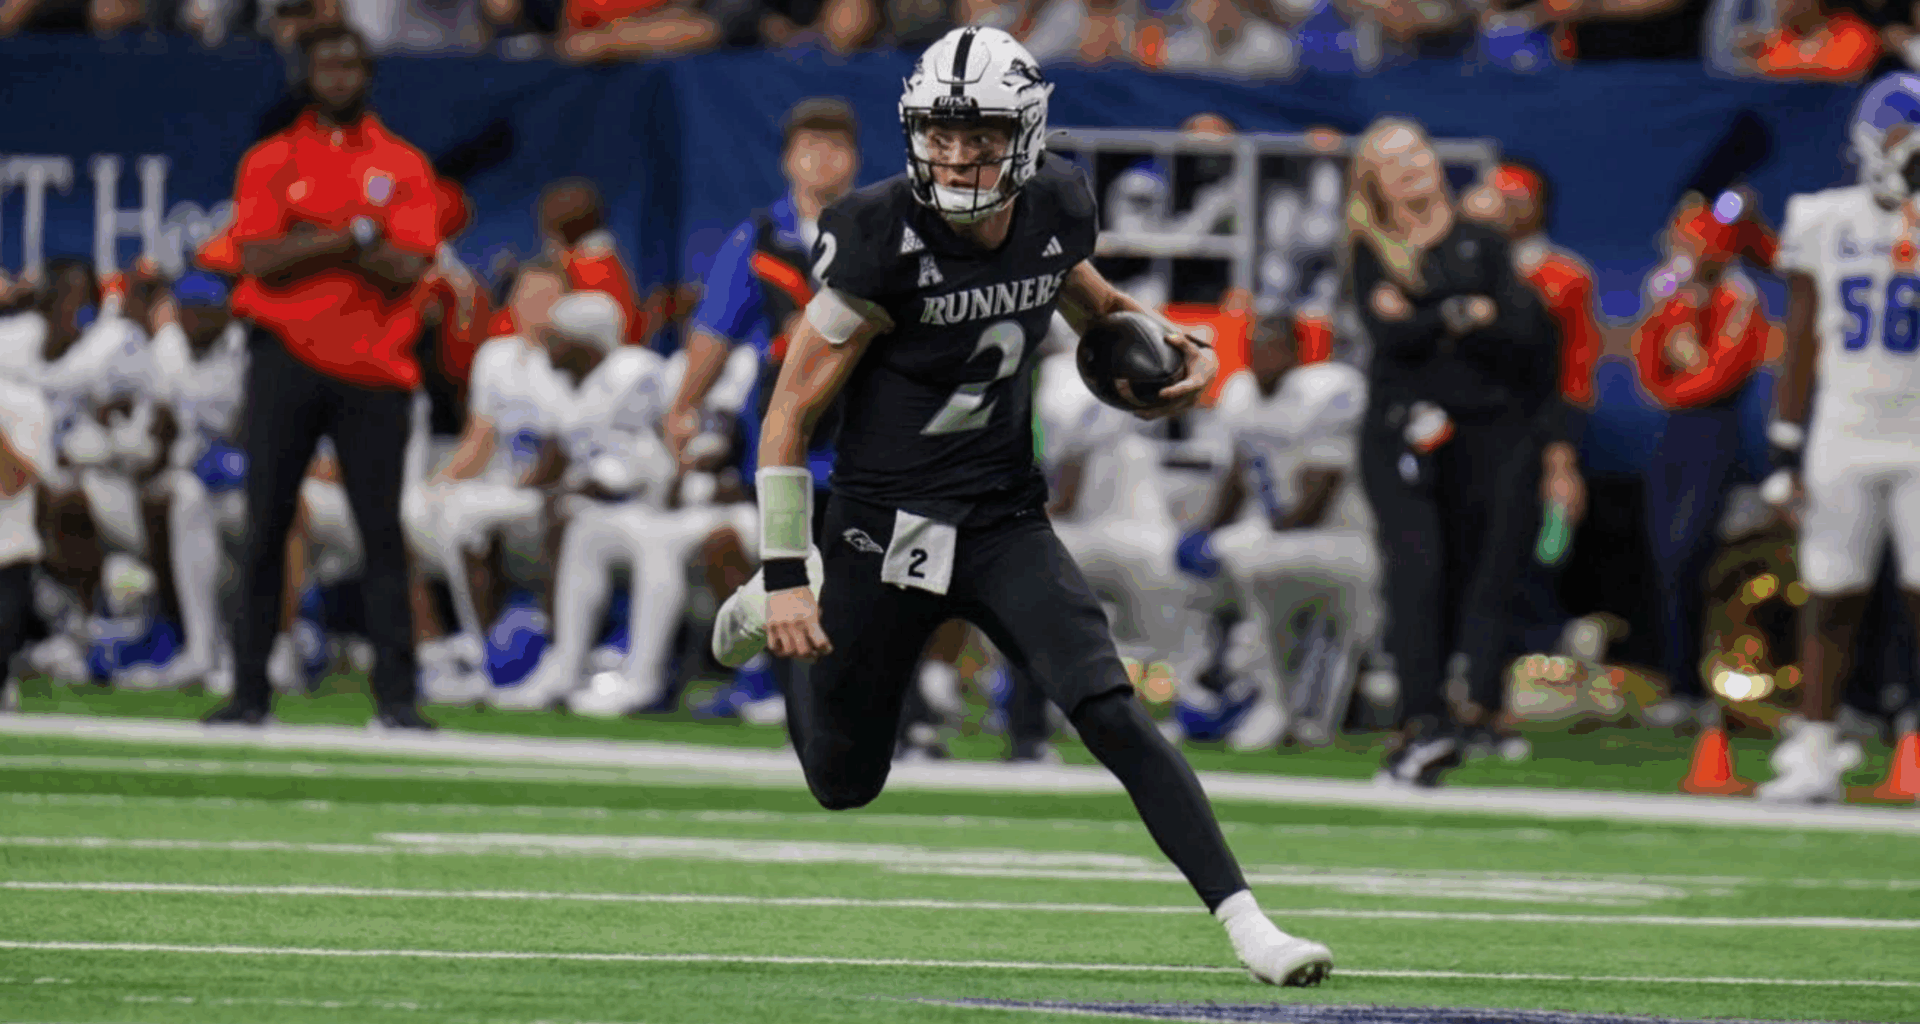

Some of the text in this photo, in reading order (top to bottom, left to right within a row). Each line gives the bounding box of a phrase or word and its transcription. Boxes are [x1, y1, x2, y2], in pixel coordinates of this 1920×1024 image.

[812, 231, 837, 286] 2
[920, 269, 1067, 325] RUNNERS
[1839, 274, 1920, 353] 56
[920, 320, 1025, 435] 2
[908, 548, 928, 579] 2
